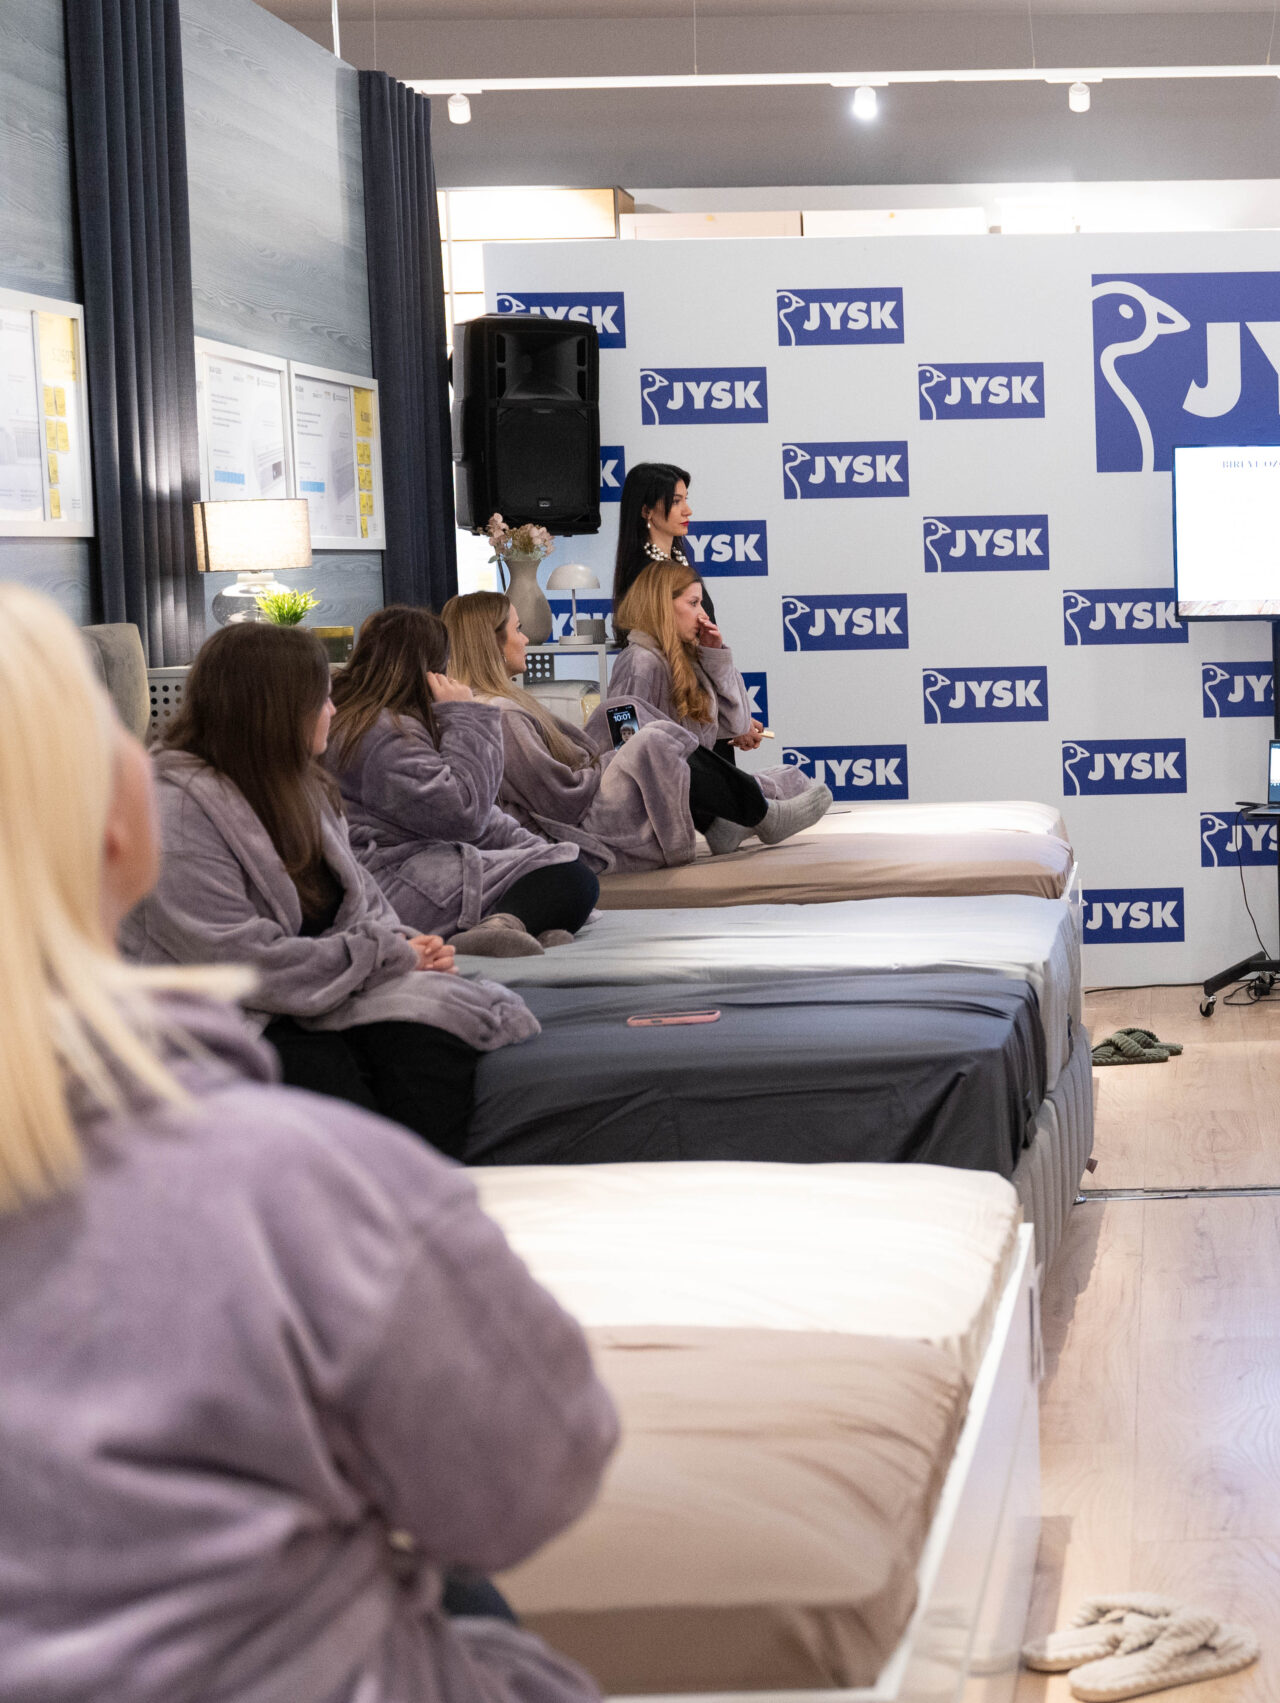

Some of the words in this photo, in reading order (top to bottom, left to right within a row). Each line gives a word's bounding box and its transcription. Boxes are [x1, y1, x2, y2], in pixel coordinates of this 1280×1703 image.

[803, 301, 898, 330] JYSK
[667, 381, 762, 409] JYSK
[944, 376, 1038, 405] JYSK
[809, 455, 903, 483] JYSK
[685, 534, 762, 562] YSK
[949, 529, 1043, 557] JYSK
[809, 607, 902, 636] JYSK
[1089, 602, 1182, 630] JYSK
[949, 680, 1042, 708] JYSK
[613, 713, 631, 722] 10:01
[811, 758, 902, 786] JYSK
[1088, 752, 1181, 780] JYSK
[1086, 901, 1179, 929] JYSK
